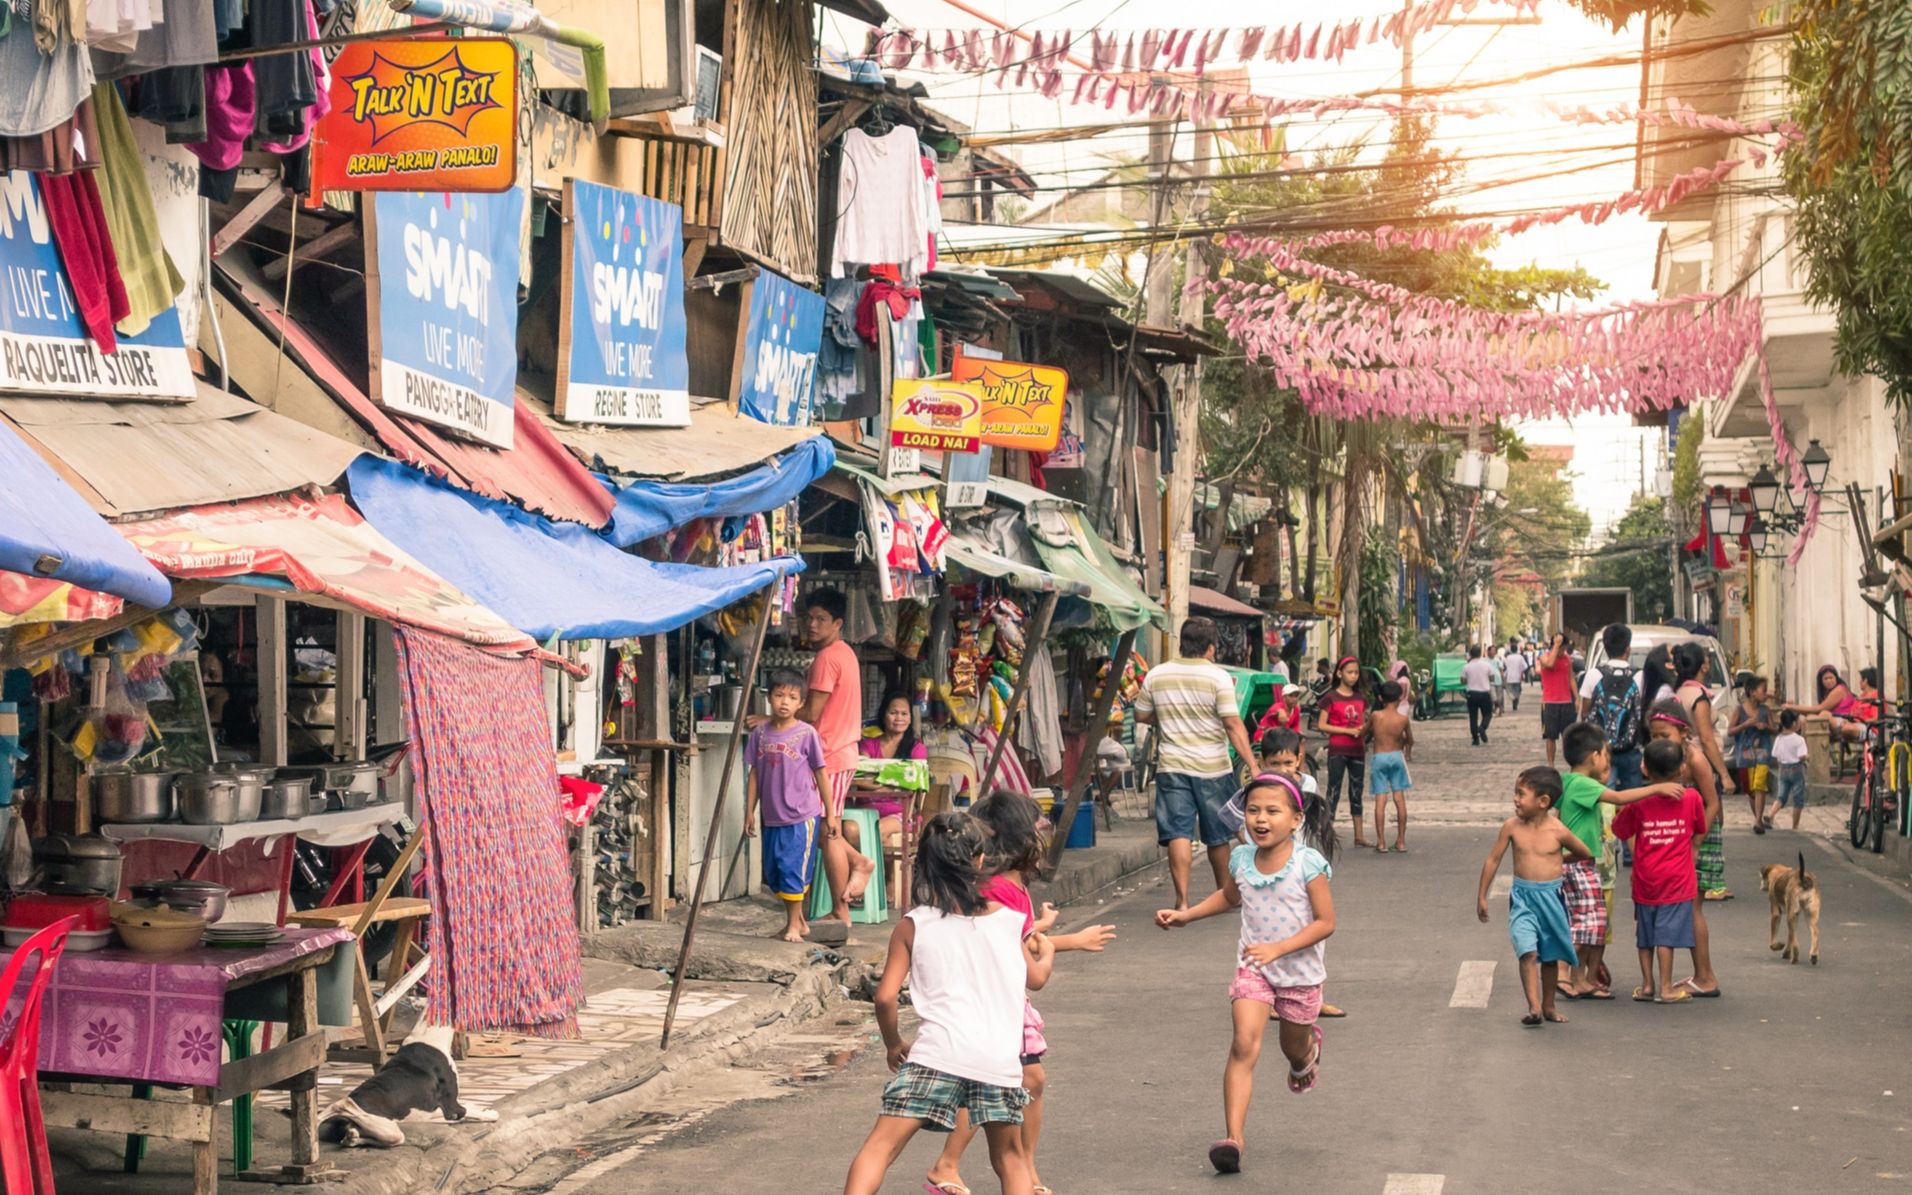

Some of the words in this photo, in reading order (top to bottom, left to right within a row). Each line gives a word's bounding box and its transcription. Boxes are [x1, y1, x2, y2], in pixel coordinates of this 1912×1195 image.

[438, 67, 494, 116] TEXT
[347, 151, 438, 175] ARAW-ARAW
[440, 146, 498, 168] PANALO!
[8, 265, 57, 321] LIVE
[403, 222, 491, 327] SMART
[593, 261, 664, 330] SMART
[2, 338, 102, 385] RAQUELITA
[103, 349, 158, 387] STORE
[423, 320, 453, 370] LIVE
[457, 331, 485, 384] MORE
[604, 341, 626, 377] LIVE
[628, 342, 654, 379] MORE
[594, 390, 627, 417] REGINE
[635, 392, 663, 419] STORE
[902, 433, 940, 447] LOAD
[943, 436, 969, 449] NA!
[228, 547, 256, 570] only
